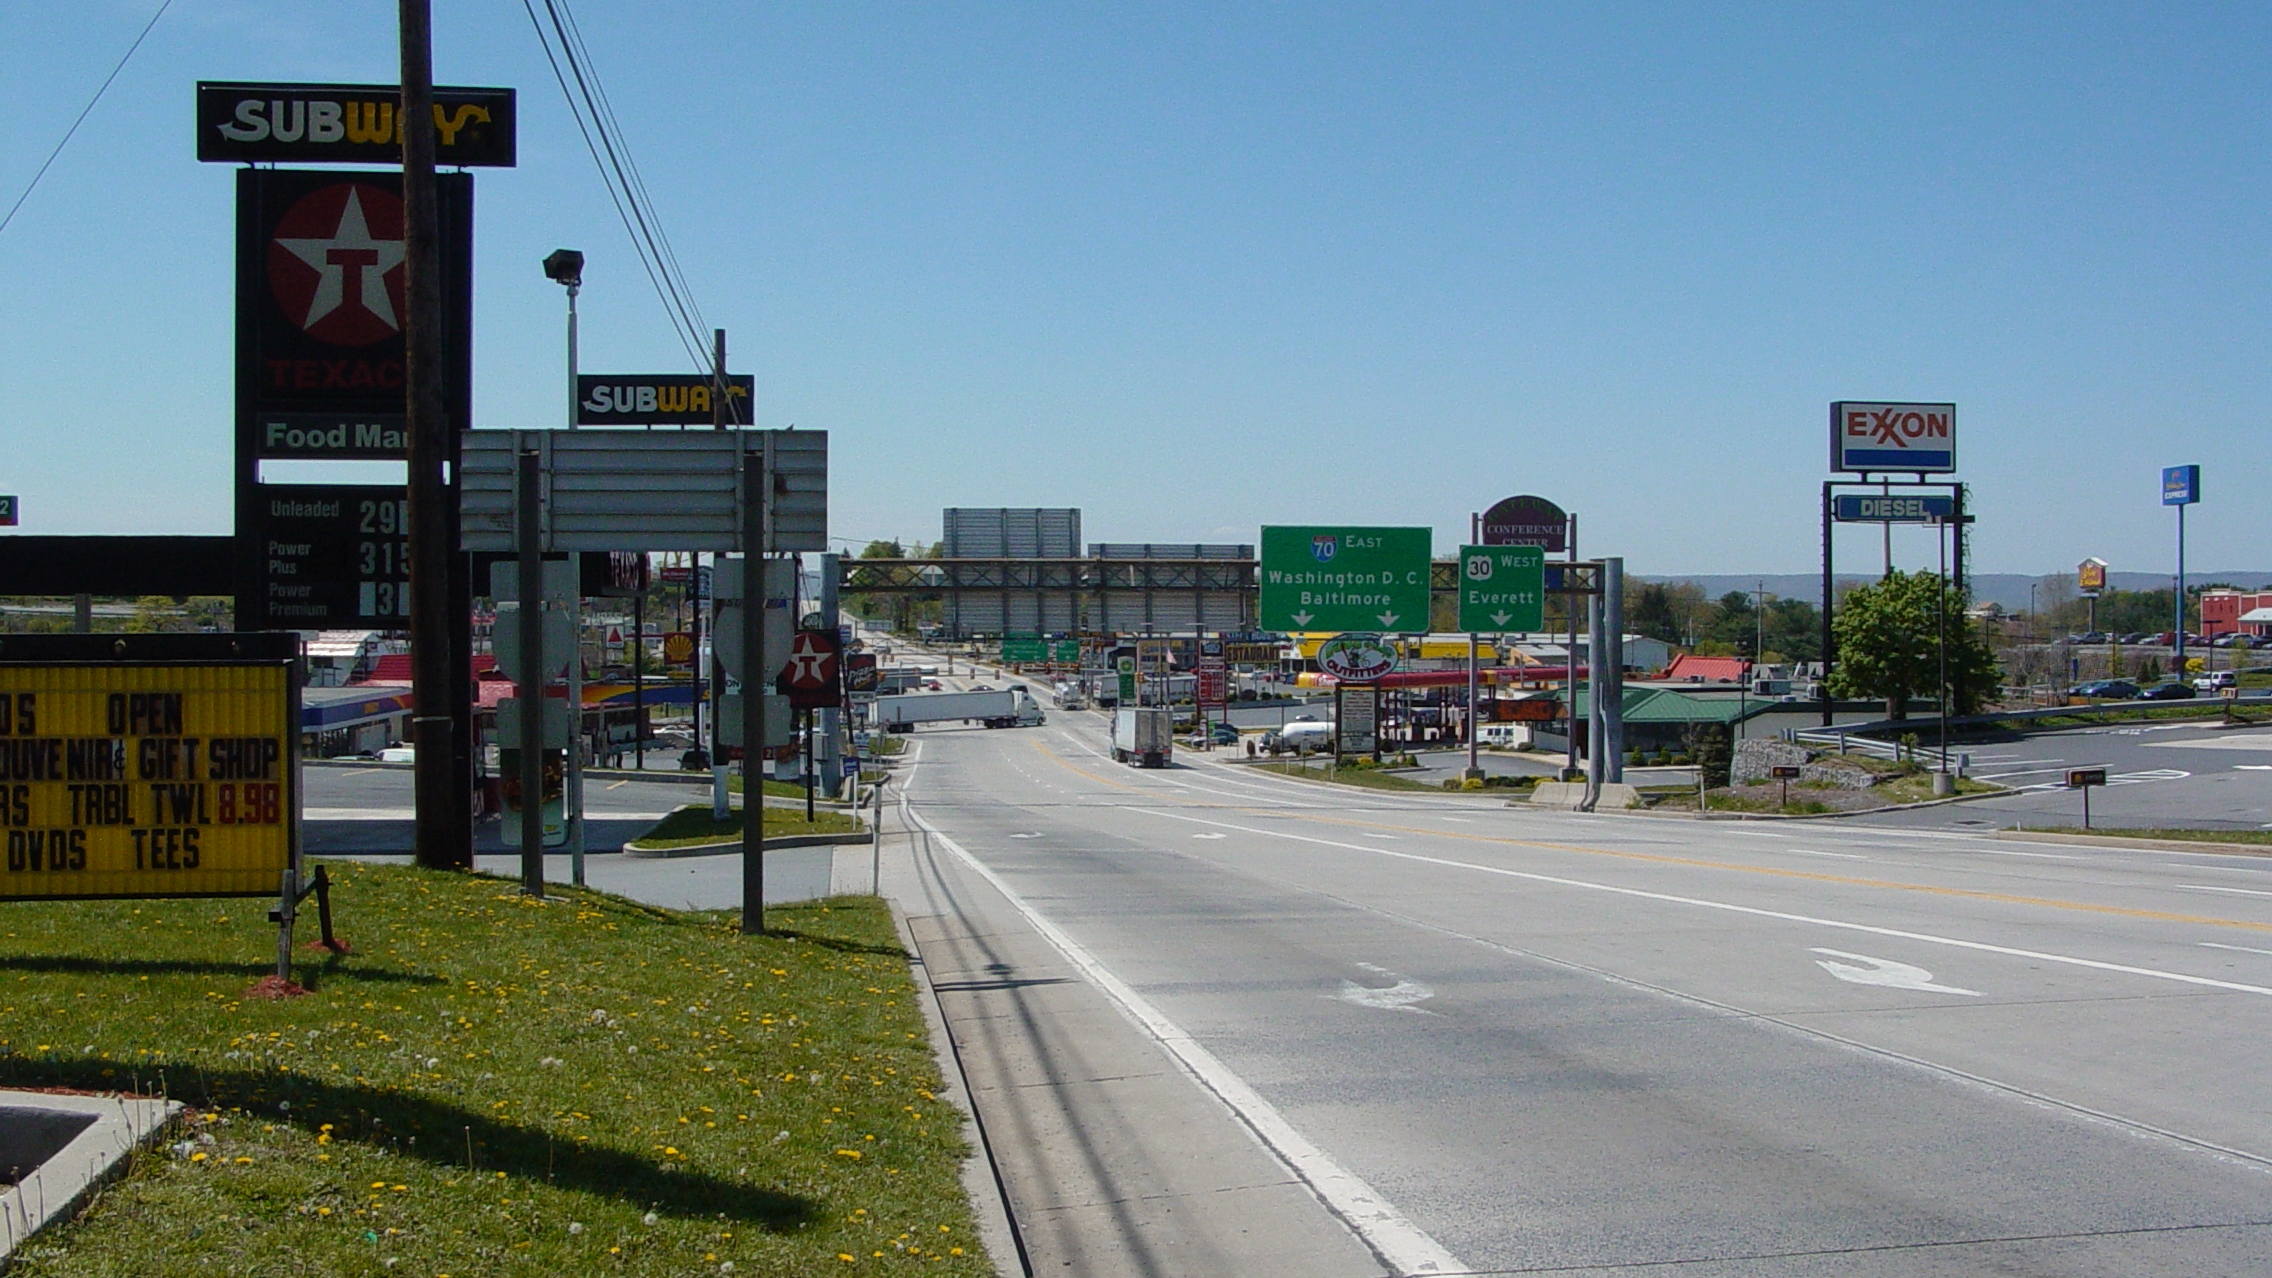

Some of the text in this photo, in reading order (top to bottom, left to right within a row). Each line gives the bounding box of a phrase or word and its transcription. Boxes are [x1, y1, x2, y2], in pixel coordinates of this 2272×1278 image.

[266, 359, 406, 389] TEXAC
[266, 422, 346, 448] Food
[1847, 407, 1948, 447] EXXON
[271, 500, 340, 518] Unleaded
[1861, 499, 1930, 517] DIESEL
[1487, 524, 1564, 535] CONFERENCE
[268, 540, 311, 556] Power
[1314, 542, 1334, 557] 70
[269, 559, 297, 575] Plus
[1469, 561, 1490, 575] 30
[1269, 570, 1375, 588] Washington
[269, 582, 312, 598] Power
[1301, 591, 1391, 605] Baltimore
[1469, 591, 1534, 604] Everett
[269, 601, 328, 616] Premium
[1326, 659, 1391, 678] OUTFITTERS
[108, 693, 183, 735] OPEN
[139, 738, 199, 779] GIFT
[209, 738, 278, 779] SHOP
[151, 784, 211, 825] TWL
[219, 783, 280, 824] 8.98
[131, 828, 200, 870] TEES
